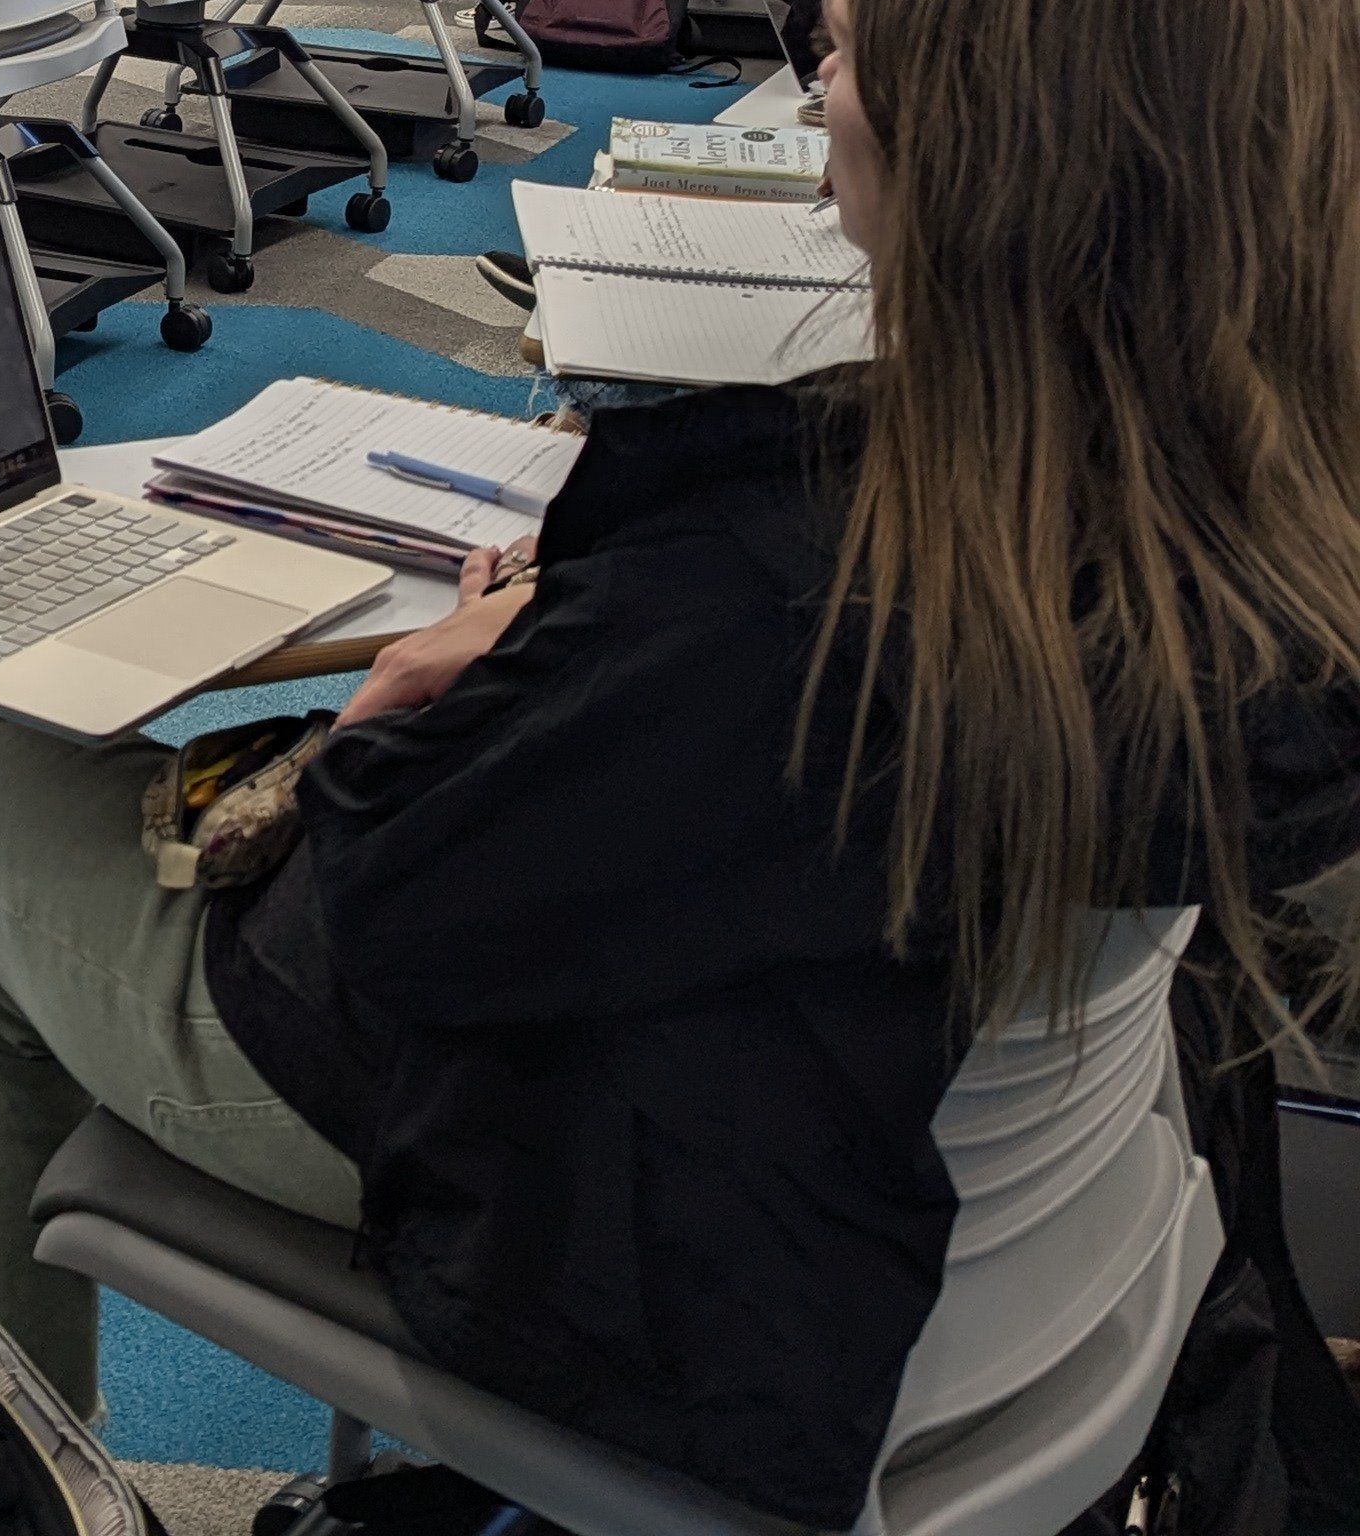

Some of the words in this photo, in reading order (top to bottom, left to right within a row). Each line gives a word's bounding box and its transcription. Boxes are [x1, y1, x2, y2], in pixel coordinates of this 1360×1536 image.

[661, 136, 691, 160] Just
[697, 132, 729, 168] Mercy
[642, 176, 670, 189] Just
[678, 178, 720, 196] Mercy
[734, 184, 766, 197] Bryan
[770, 187, 821, 201] Stevenso
